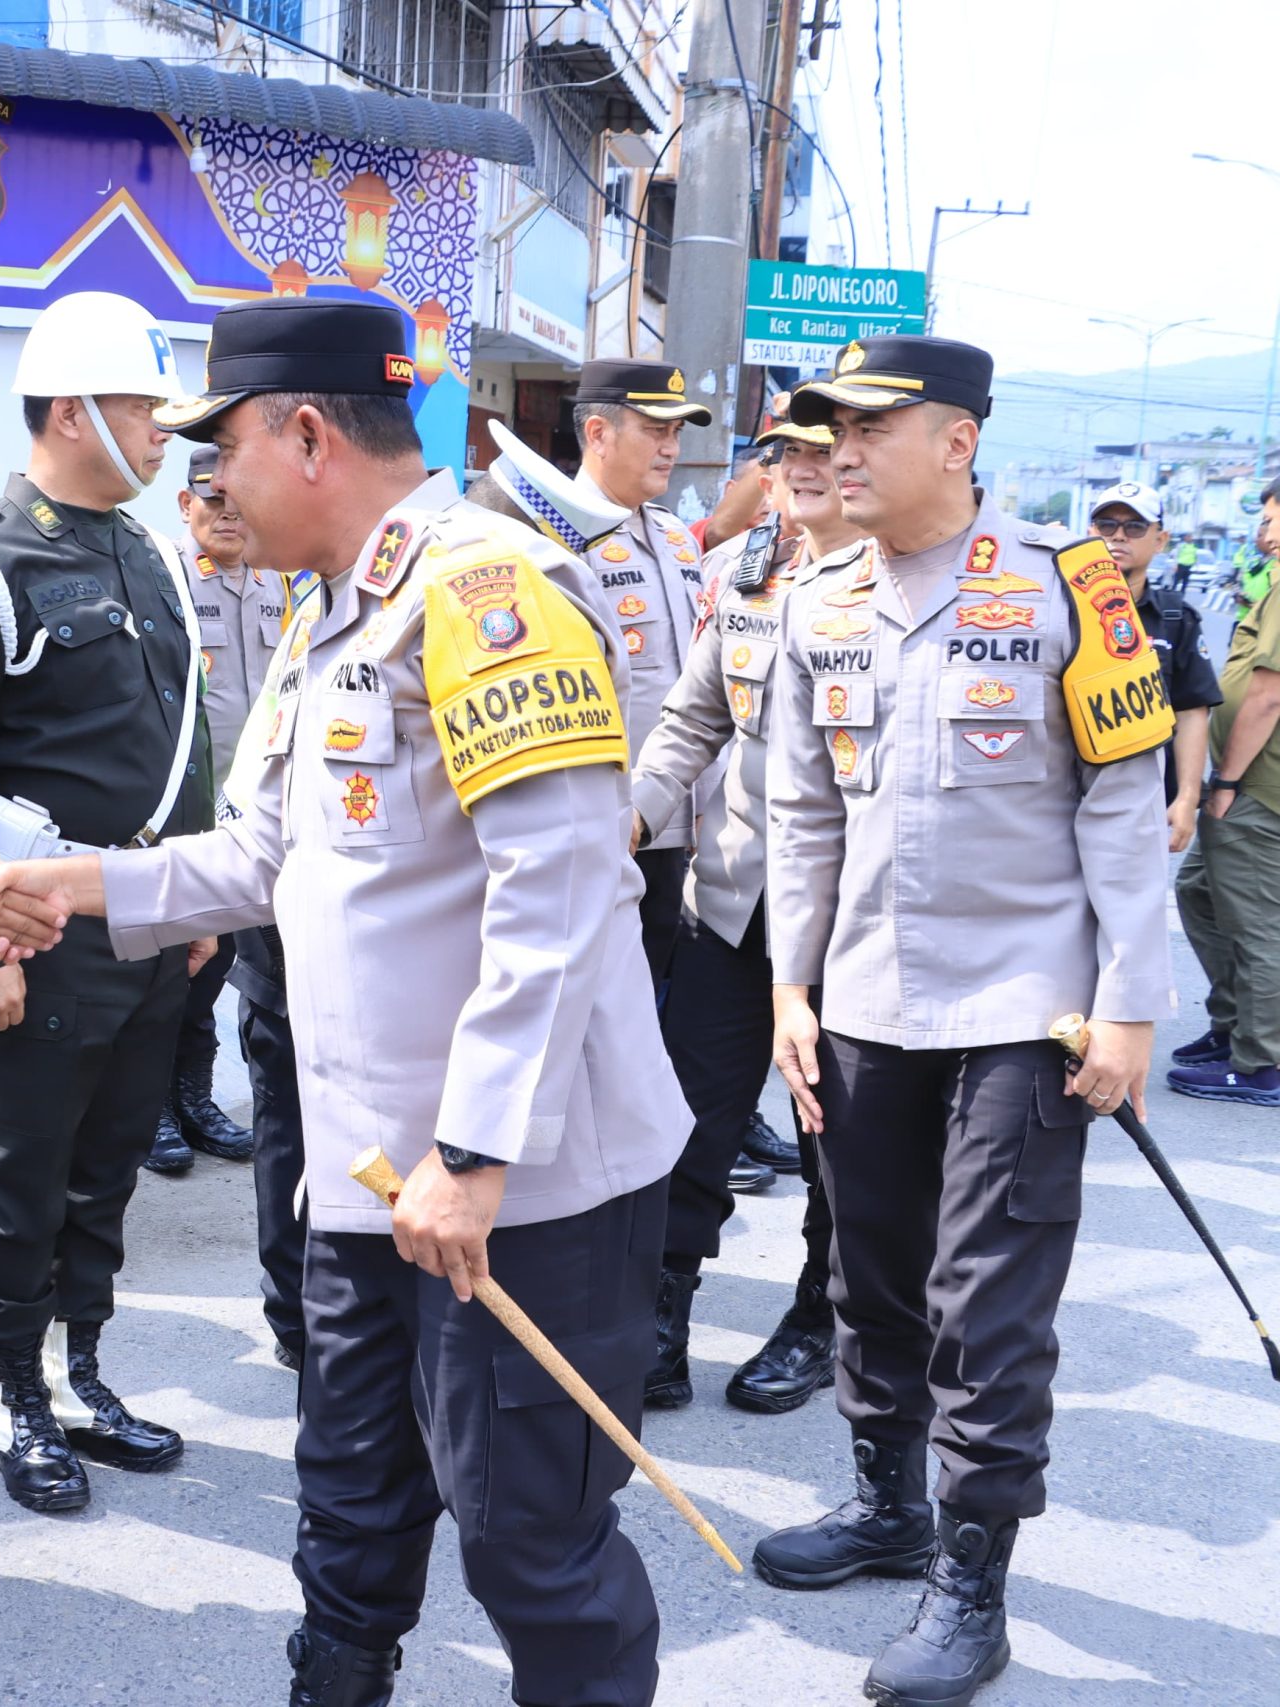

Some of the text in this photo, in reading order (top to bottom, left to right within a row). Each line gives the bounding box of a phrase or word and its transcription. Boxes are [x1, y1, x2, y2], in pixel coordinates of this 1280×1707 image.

[770, 316, 792, 335] Kec
[801, 319, 847, 338] Rantau
[146, 329, 170, 375] P
[798, 346, 831, 364] JALA
[391, 360, 414, 380] KAP
[454, 566, 510, 591] POLDA
[601, 569, 646, 588] SASTRA
[260, 604, 282, 618] POLR
[727, 614, 779, 638] SONNY
[807, 648, 872, 672] WAHYU
[946, 638, 1040, 663] POLRI
[330, 661, 380, 693] POLRI
[443, 668, 602, 746] KAOPSDA
[1087, 669, 1170, 734] KAOPS
[452, 749, 475, 773] OPS
